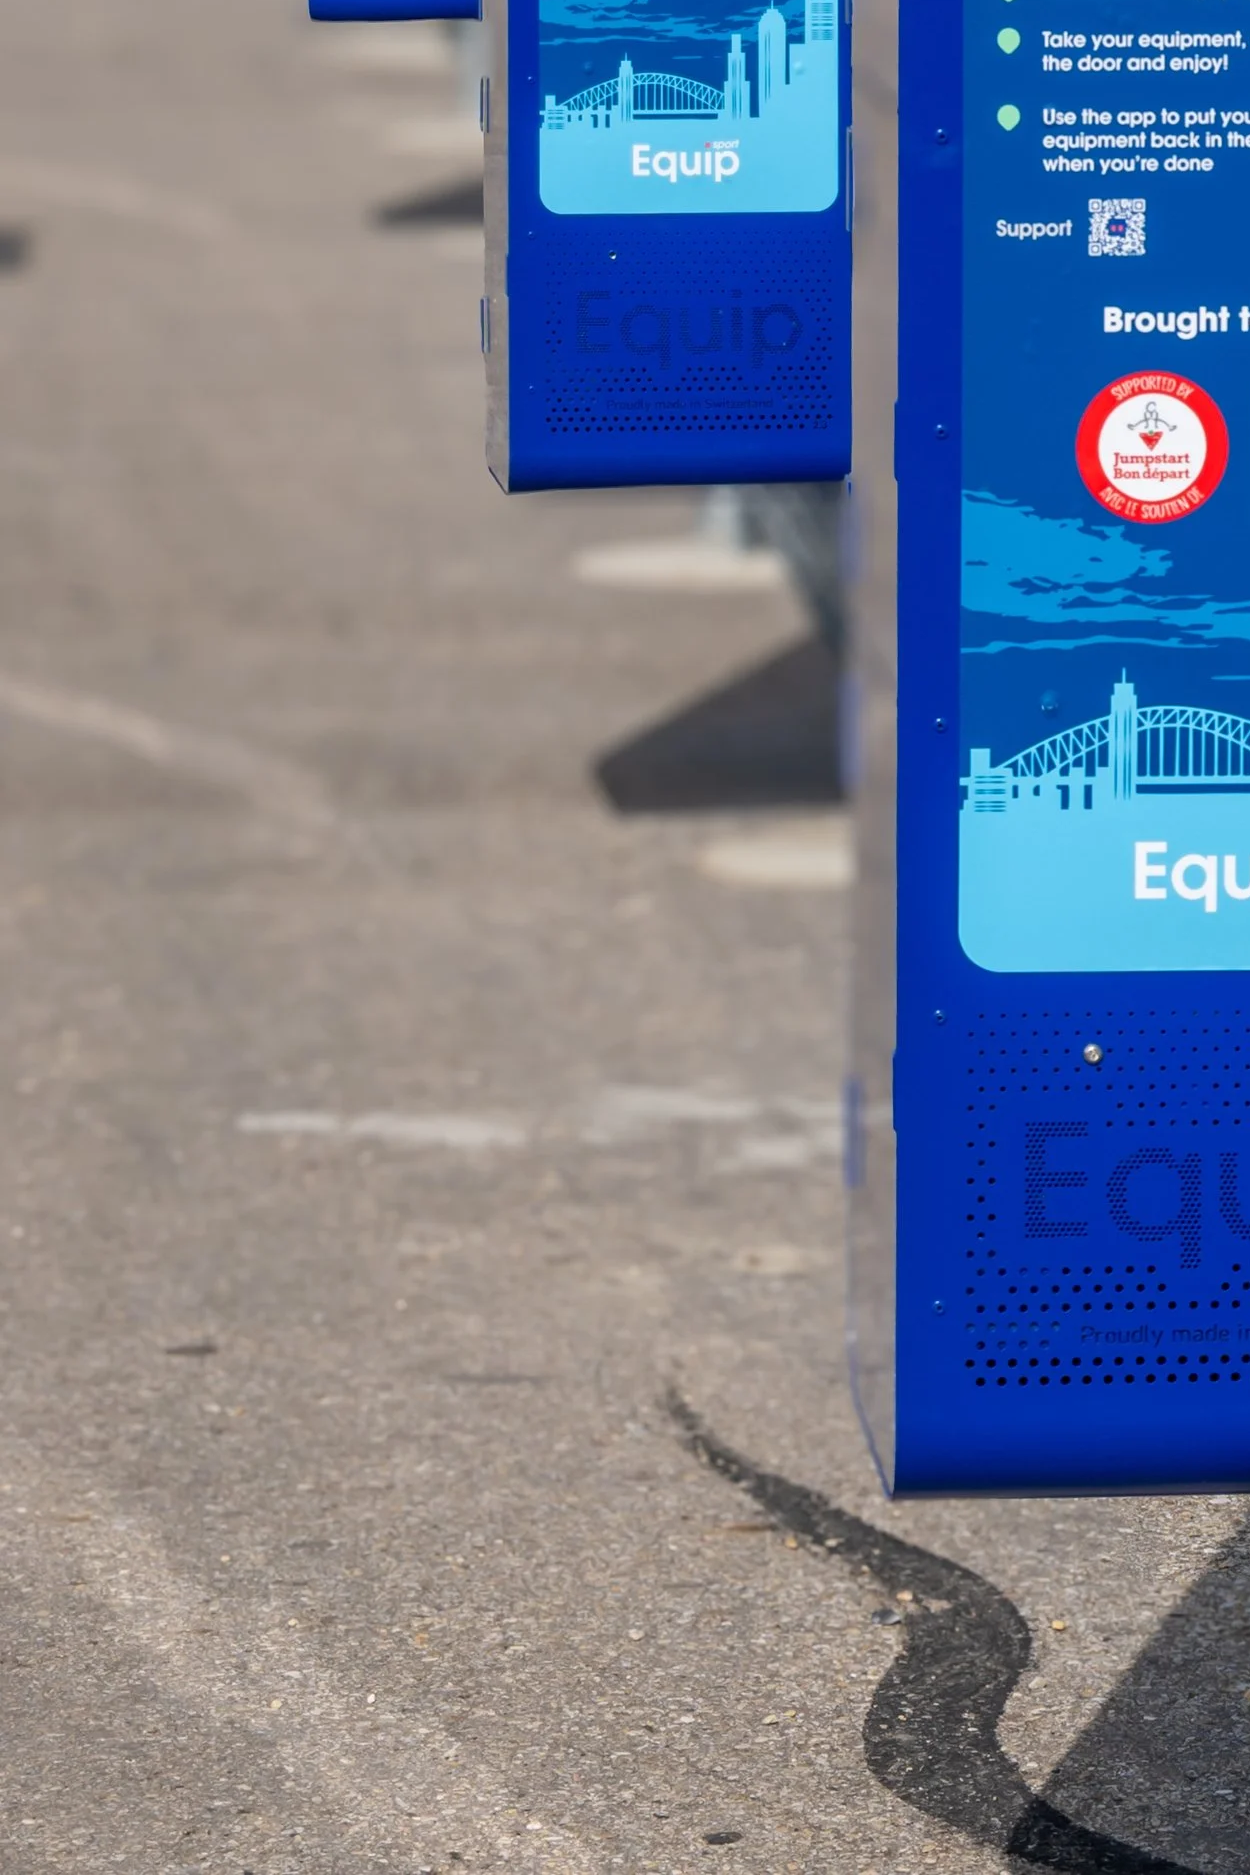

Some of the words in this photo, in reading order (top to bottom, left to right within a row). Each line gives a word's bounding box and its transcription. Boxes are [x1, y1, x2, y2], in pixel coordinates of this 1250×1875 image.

[1042, 31, 1086, 48] Take
[1092, 34, 1134, 51] your
[1138, 31, 1246, 51] equipment,
[1042, 55, 1072, 71] the
[1078, 55, 1122, 71] door
[1127, 54, 1165, 71] and
[1170, 54, 1228, 74] enjoy!
[1043, 108, 1076, 125] Use
[1081, 109, 1112, 125] the
[1117, 111, 1156, 128] app
[1161, 108, 1180, 125] to
[1184, 108, 1216, 127] put
[713, 139, 739, 149] sport
[1042, 132, 1146, 151] equipment
[1150, 131, 1200, 148] back
[1206, 132, 1222, 147] in
[632, 142, 740, 183] Equip
[1043, 155, 1094, 172] when
[1100, 155, 1159, 175] you’re
[1164, 155, 1214, 171] done
[996, 220, 1072, 240] Support
[576, 289, 803, 370] Equip
[1104, 306, 1230, 339] Brought
[1111, 376, 1176, 400] SUPPORTED
[1176, 382, 1195, 399] BY
[1114, 452, 1190, 467] Jumpstart
[1113, 468, 1140, 479] Bon
[1143, 468, 1190, 482] départ
[1098, 486, 1126, 510] AVEC
[1125, 501, 1139, 517] LE
[1141, 496, 1190, 519] SOUTIEN
[1081, 1324, 1164, 1346] Proudly
[1172, 1324, 1230, 1343] made
